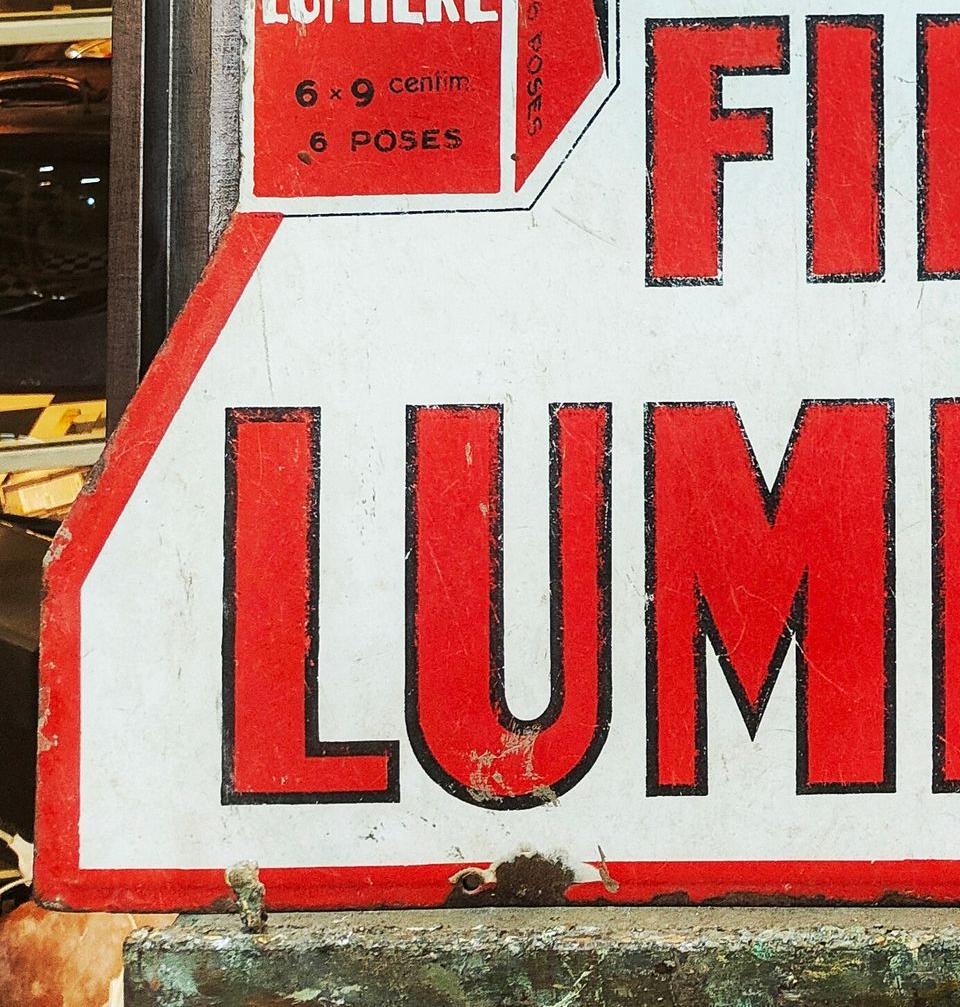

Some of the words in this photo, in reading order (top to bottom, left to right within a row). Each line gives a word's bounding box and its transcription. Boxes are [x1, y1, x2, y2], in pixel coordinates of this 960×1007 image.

[295, 79, 319, 108] 6
[350, 77, 376, 107] 9
[309, 130, 328, 153] 6
[350, 128, 463, 153] POSES
